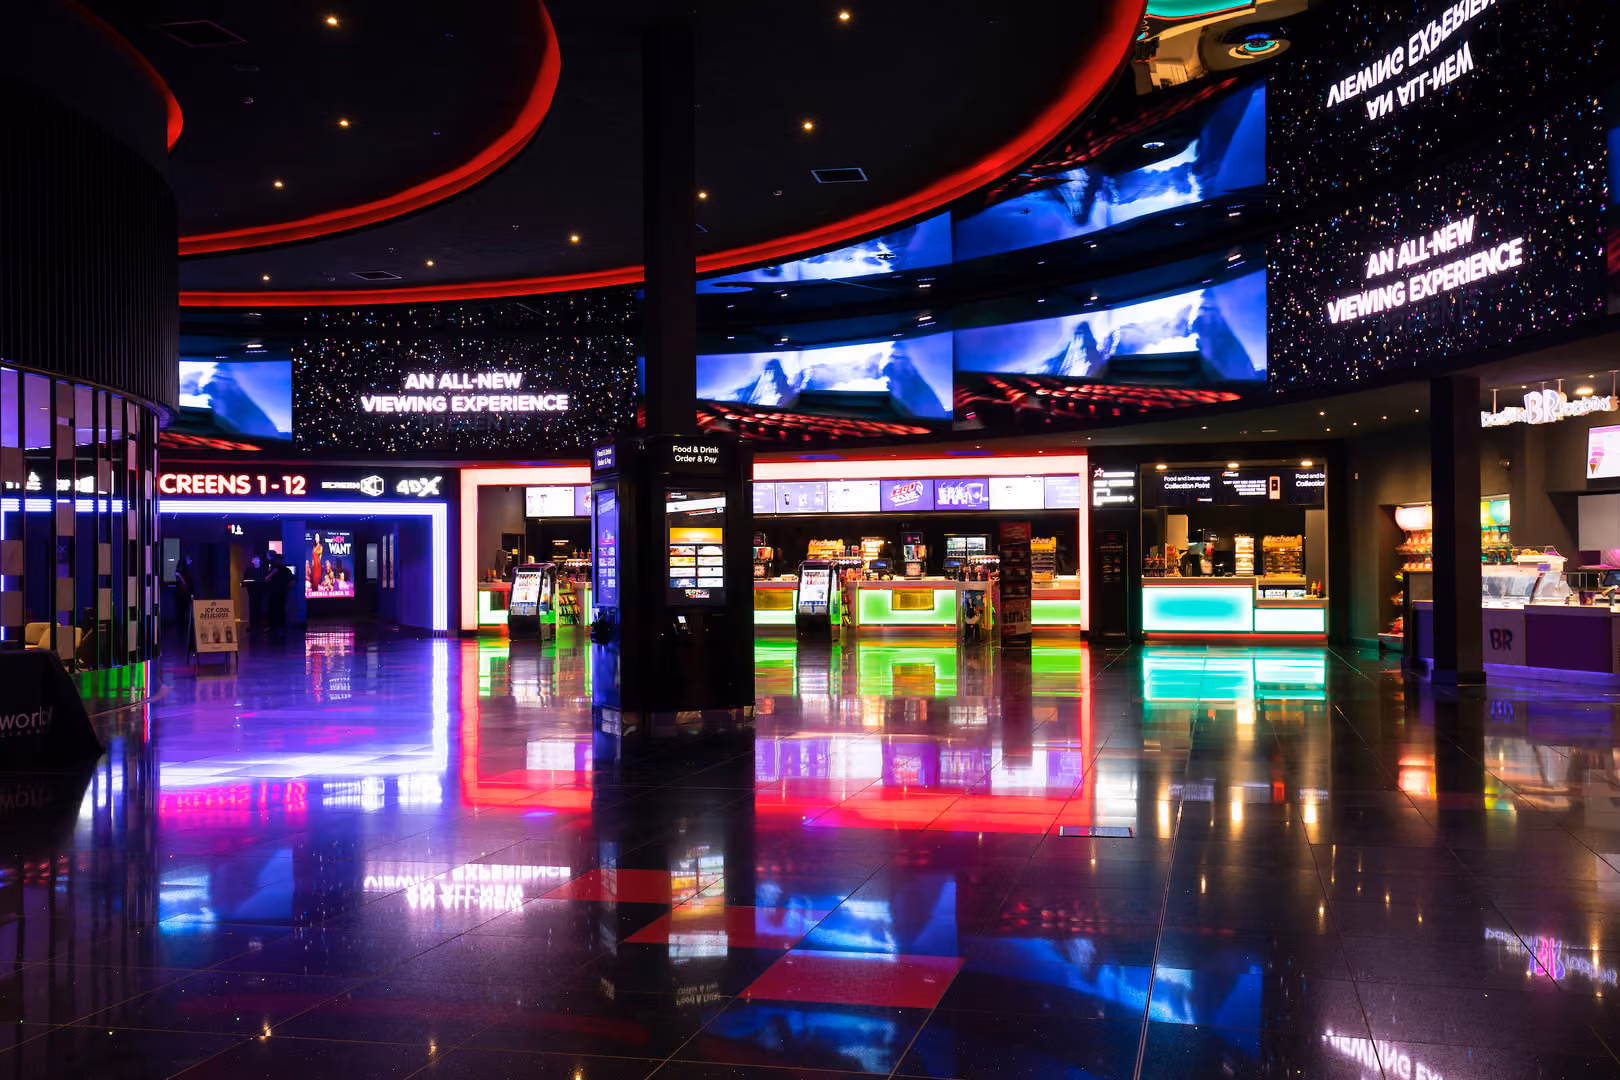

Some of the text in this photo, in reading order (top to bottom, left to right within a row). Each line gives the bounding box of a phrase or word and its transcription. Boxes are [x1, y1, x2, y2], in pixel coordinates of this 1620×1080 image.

[1366, 215, 1475, 278] AN ALL-NEW
[1326, 281, 1406, 324] VIEWING
[1409, 237, 1523, 301] EXPERIENCE
[405, 373, 522, 389] AN ALL-NEW
[361, 394, 568, 412] VIEWING EXPERIENCE
[673, 445, 691, 453] Food
[700, 446, 719, 454] Drink
[704, 456, 717, 464] Pay
[159, 473, 251, 495] CREENS
[257, 475, 267, 494] 1
[282, 475, 306, 495] 12
[328, 543, 352, 555] WANT
[1490, 628, 1513, 651] BR
